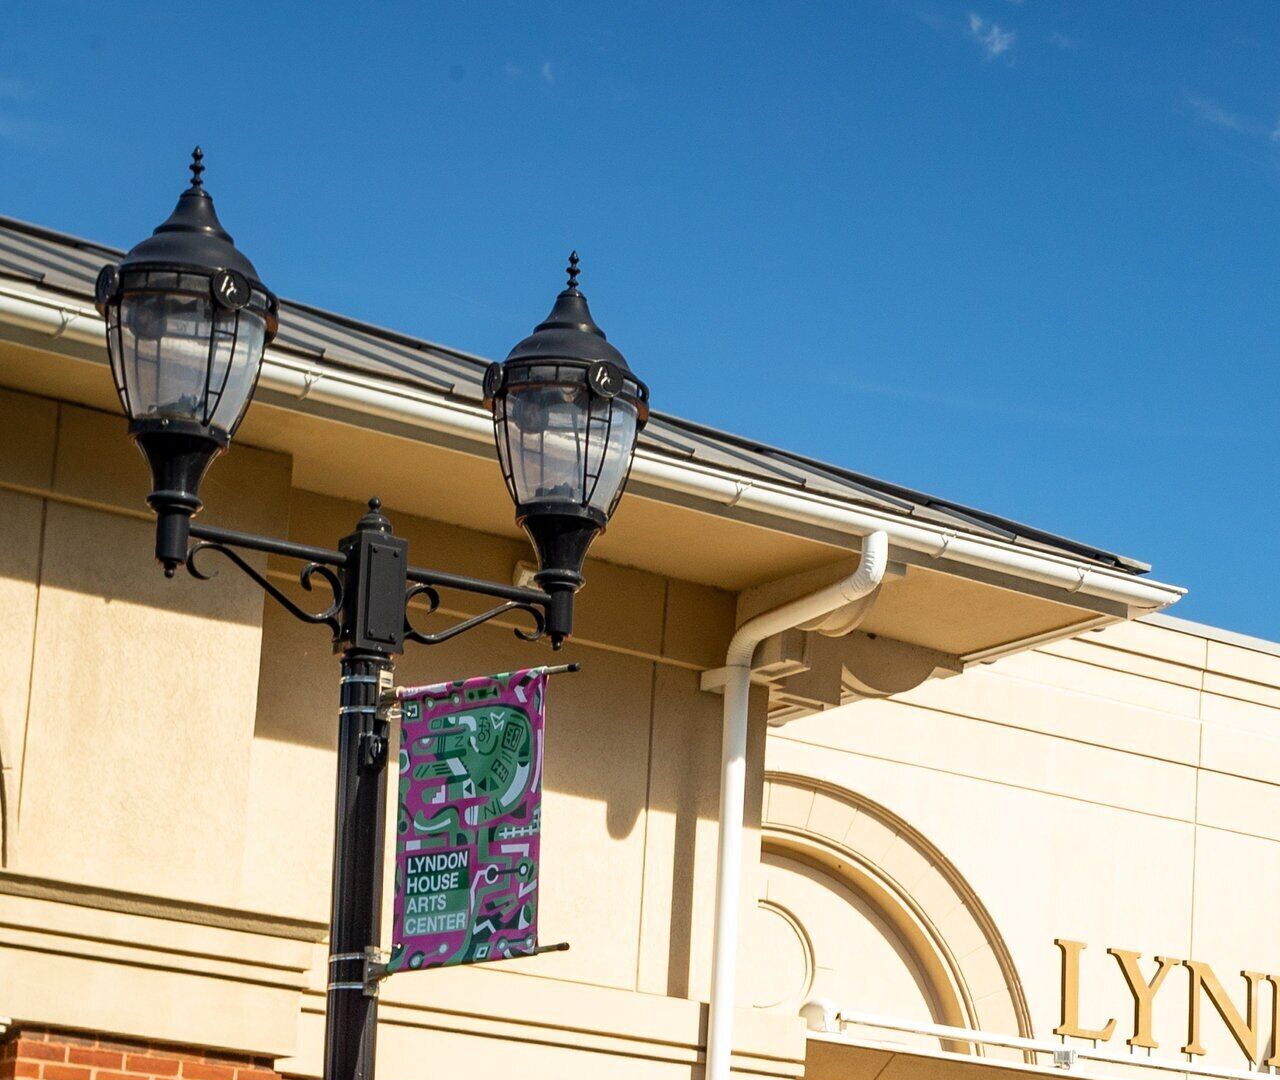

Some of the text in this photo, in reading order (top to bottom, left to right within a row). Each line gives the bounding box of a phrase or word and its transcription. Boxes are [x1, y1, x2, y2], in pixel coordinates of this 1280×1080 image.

[407, 851, 468, 874] LYNDON
[406, 872, 459, 894] HOUSE
[406, 894, 447, 914] ARTS
[405, 912, 466, 935] CENTER
